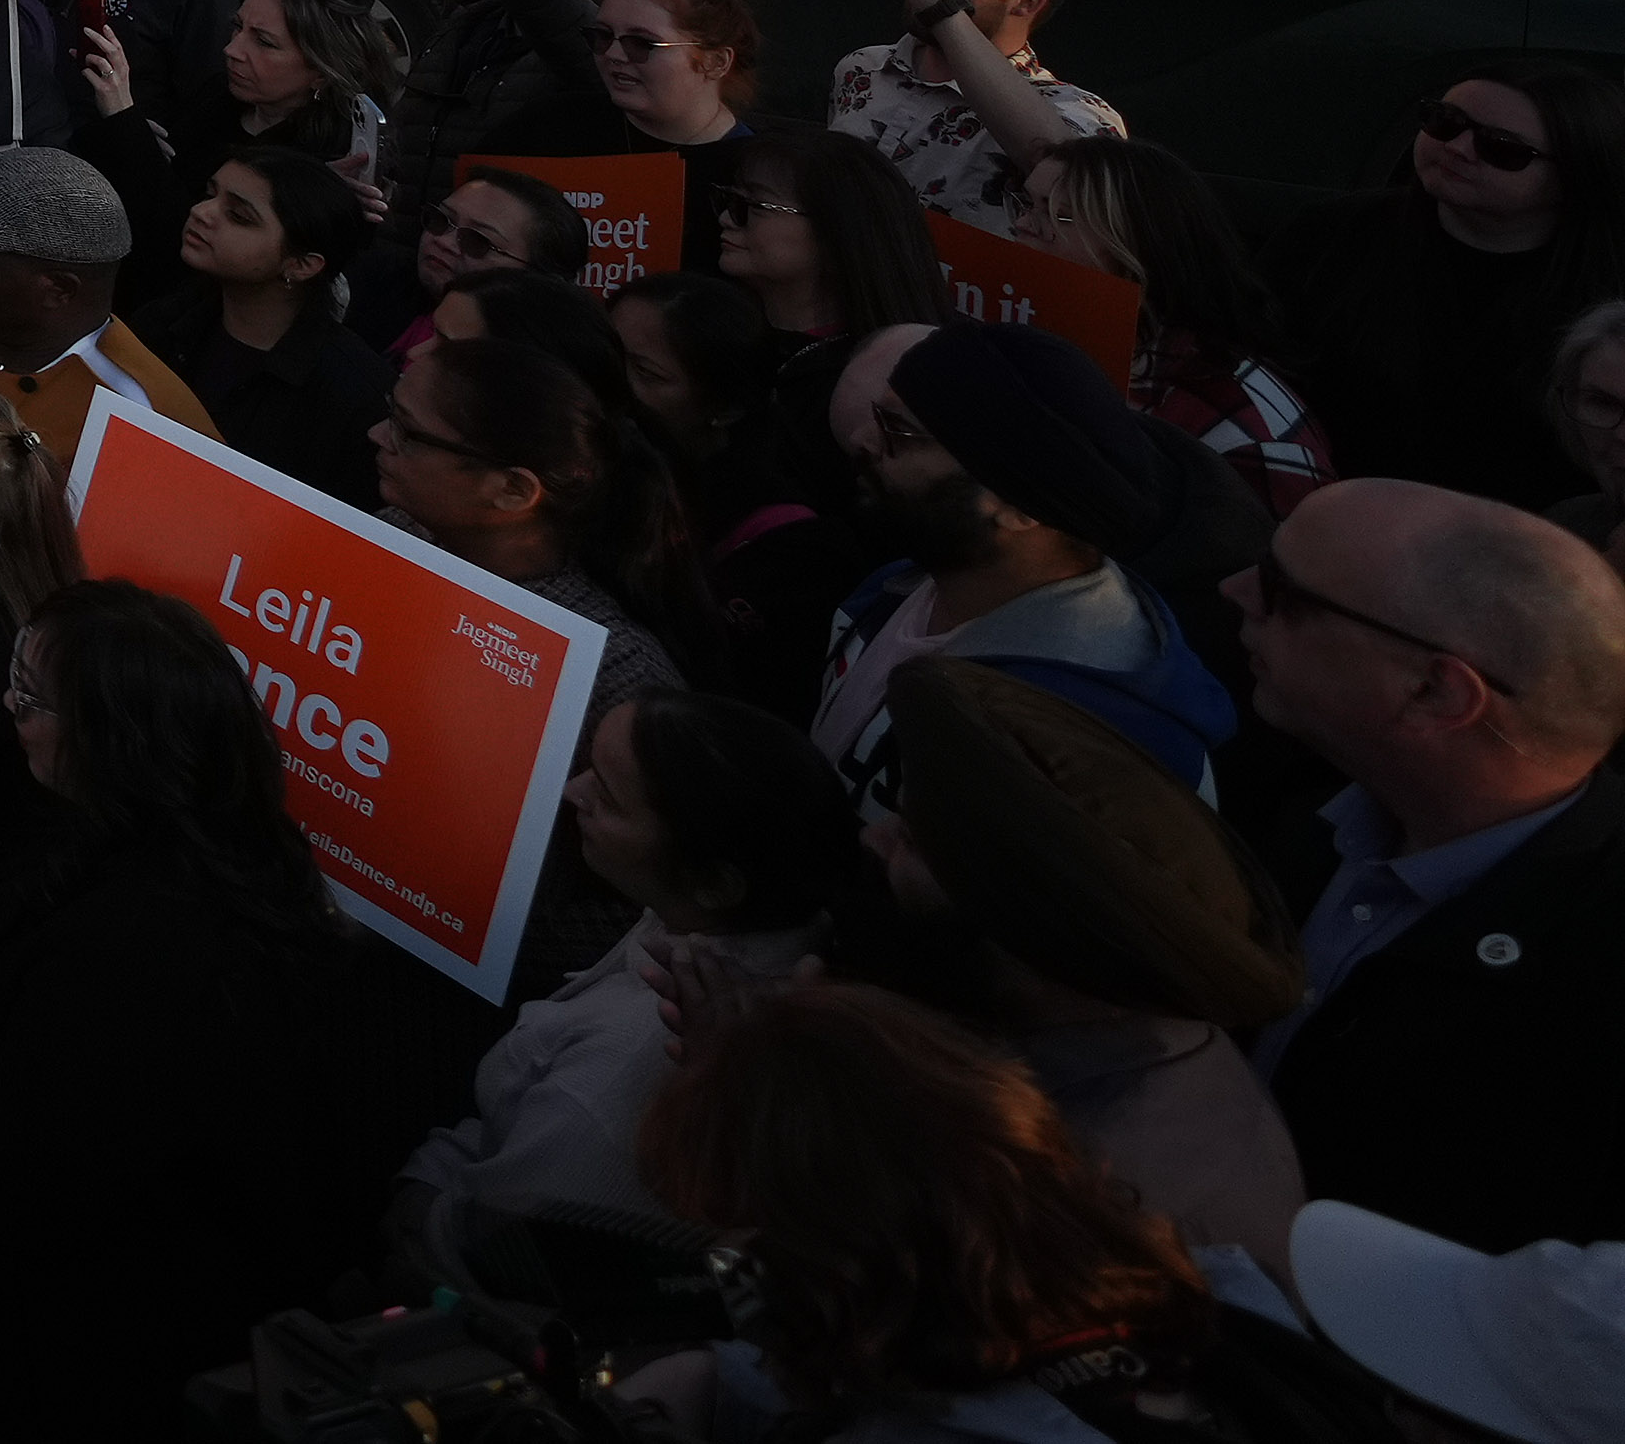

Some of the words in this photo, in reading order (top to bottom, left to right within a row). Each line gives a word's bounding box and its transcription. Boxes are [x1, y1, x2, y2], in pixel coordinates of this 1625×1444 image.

[1000, 282, 1035, 324] it
[218, 551, 365, 678] Leila
[451, 612, 542, 672] Jagmeet
[478, 648, 536, 690] Singh
[298, 819, 466, 935] LeilaDance.ndp.ca
